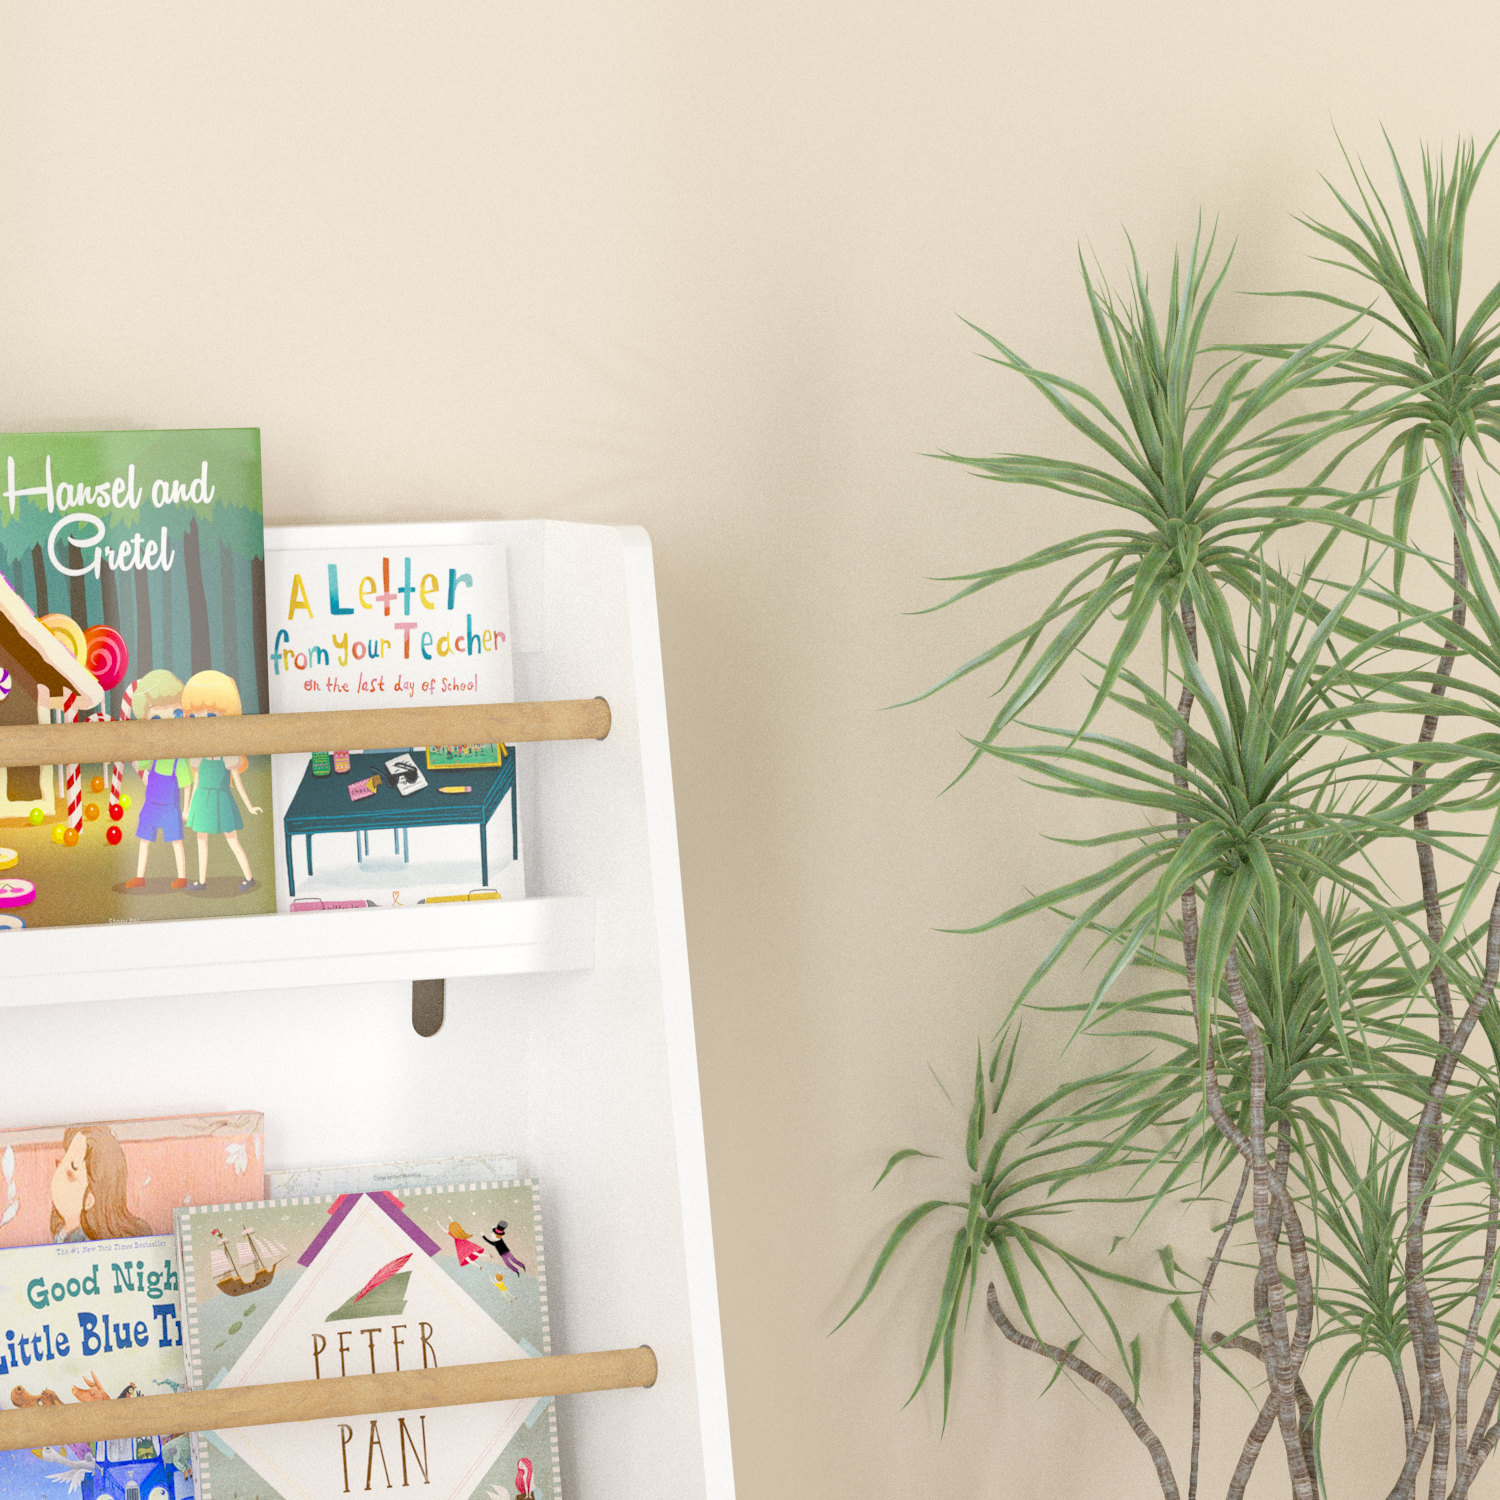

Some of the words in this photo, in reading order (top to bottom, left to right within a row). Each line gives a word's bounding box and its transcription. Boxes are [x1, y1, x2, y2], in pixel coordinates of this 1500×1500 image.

[3, 455, 142, 514] Hansel
[151, 460, 216, 508] and
[47, 512, 175, 580] Gretel
[288, 574, 313, 620] A
[327, 557, 473, 616] Letter
[270, 629, 329, 675] from
[332, 633, 391, 667] your
[394, 614, 506, 660] Teacher
[304, 679, 321, 692] on
[326, 677, 349, 693] the
[357, 672, 384, 694] last
[394, 674, 415, 698] day
[421, 678, 436, 695] of
[442, 673, 478, 693] School
[27, 1264, 100, 1309] Good
[77, 1312, 149, 1357] Blue
[311, 1322, 438, 1379] PETER
[337, 1415, 431, 1493] PAN
